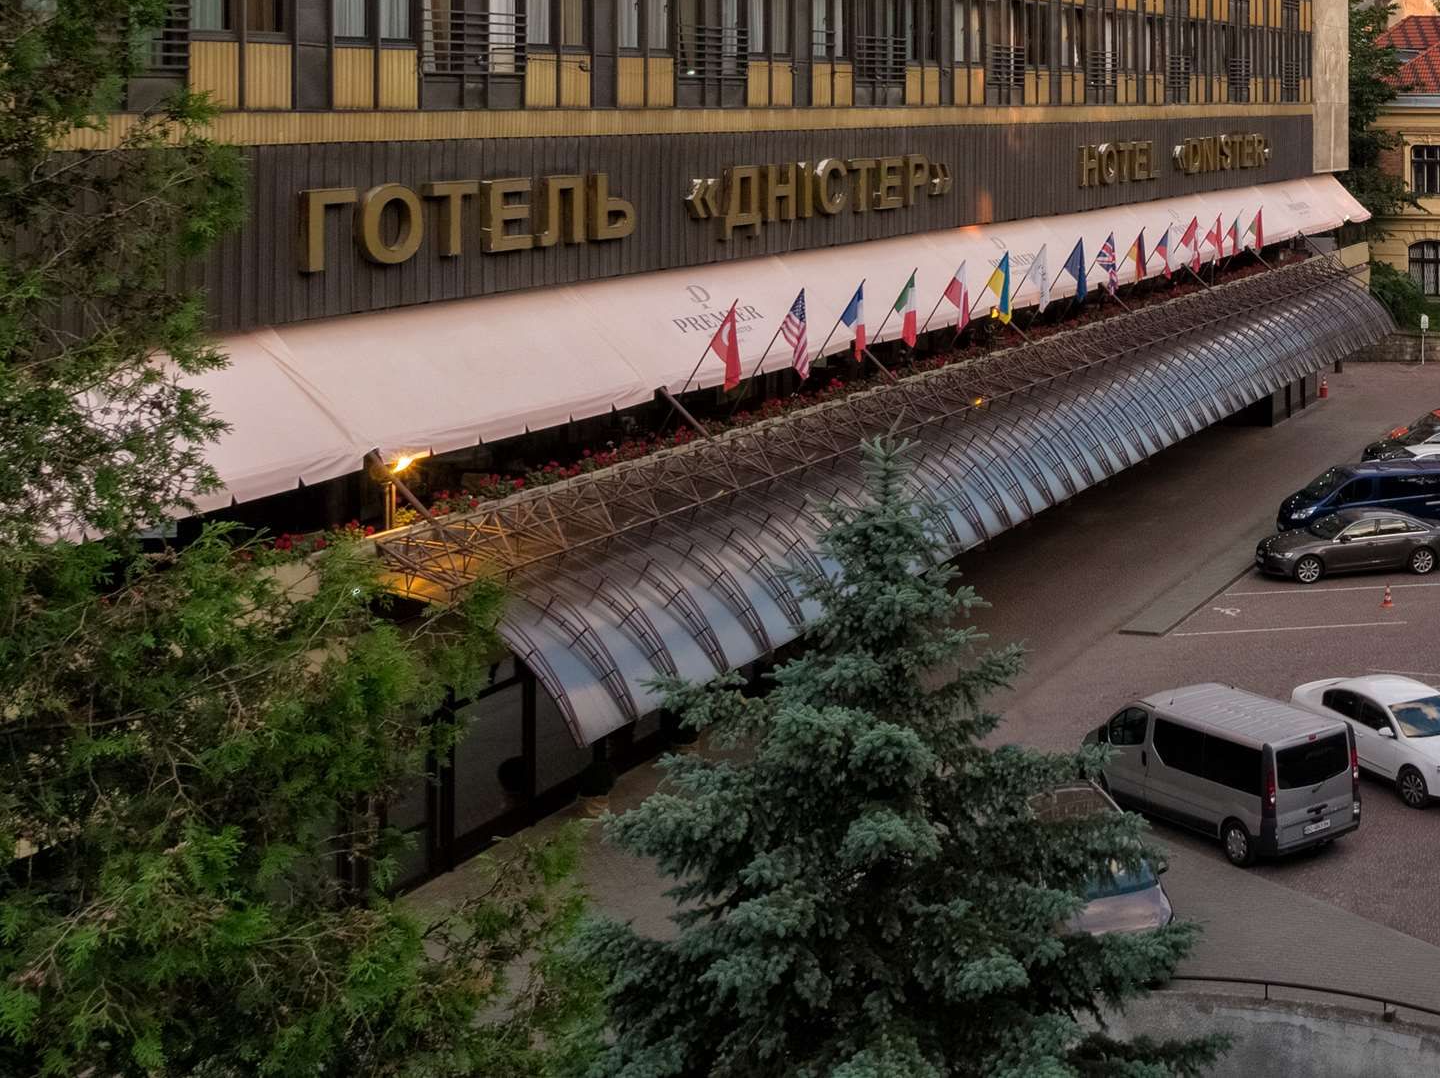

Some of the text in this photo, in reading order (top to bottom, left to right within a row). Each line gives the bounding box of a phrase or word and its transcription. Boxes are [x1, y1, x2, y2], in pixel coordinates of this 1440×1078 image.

[1079, 141, 1160, 187] HOTEL
[298, 153, 952, 273] ГОТЕЛЬ «ДНІСТЕР»
[672, 305, 765, 333] PREMER
